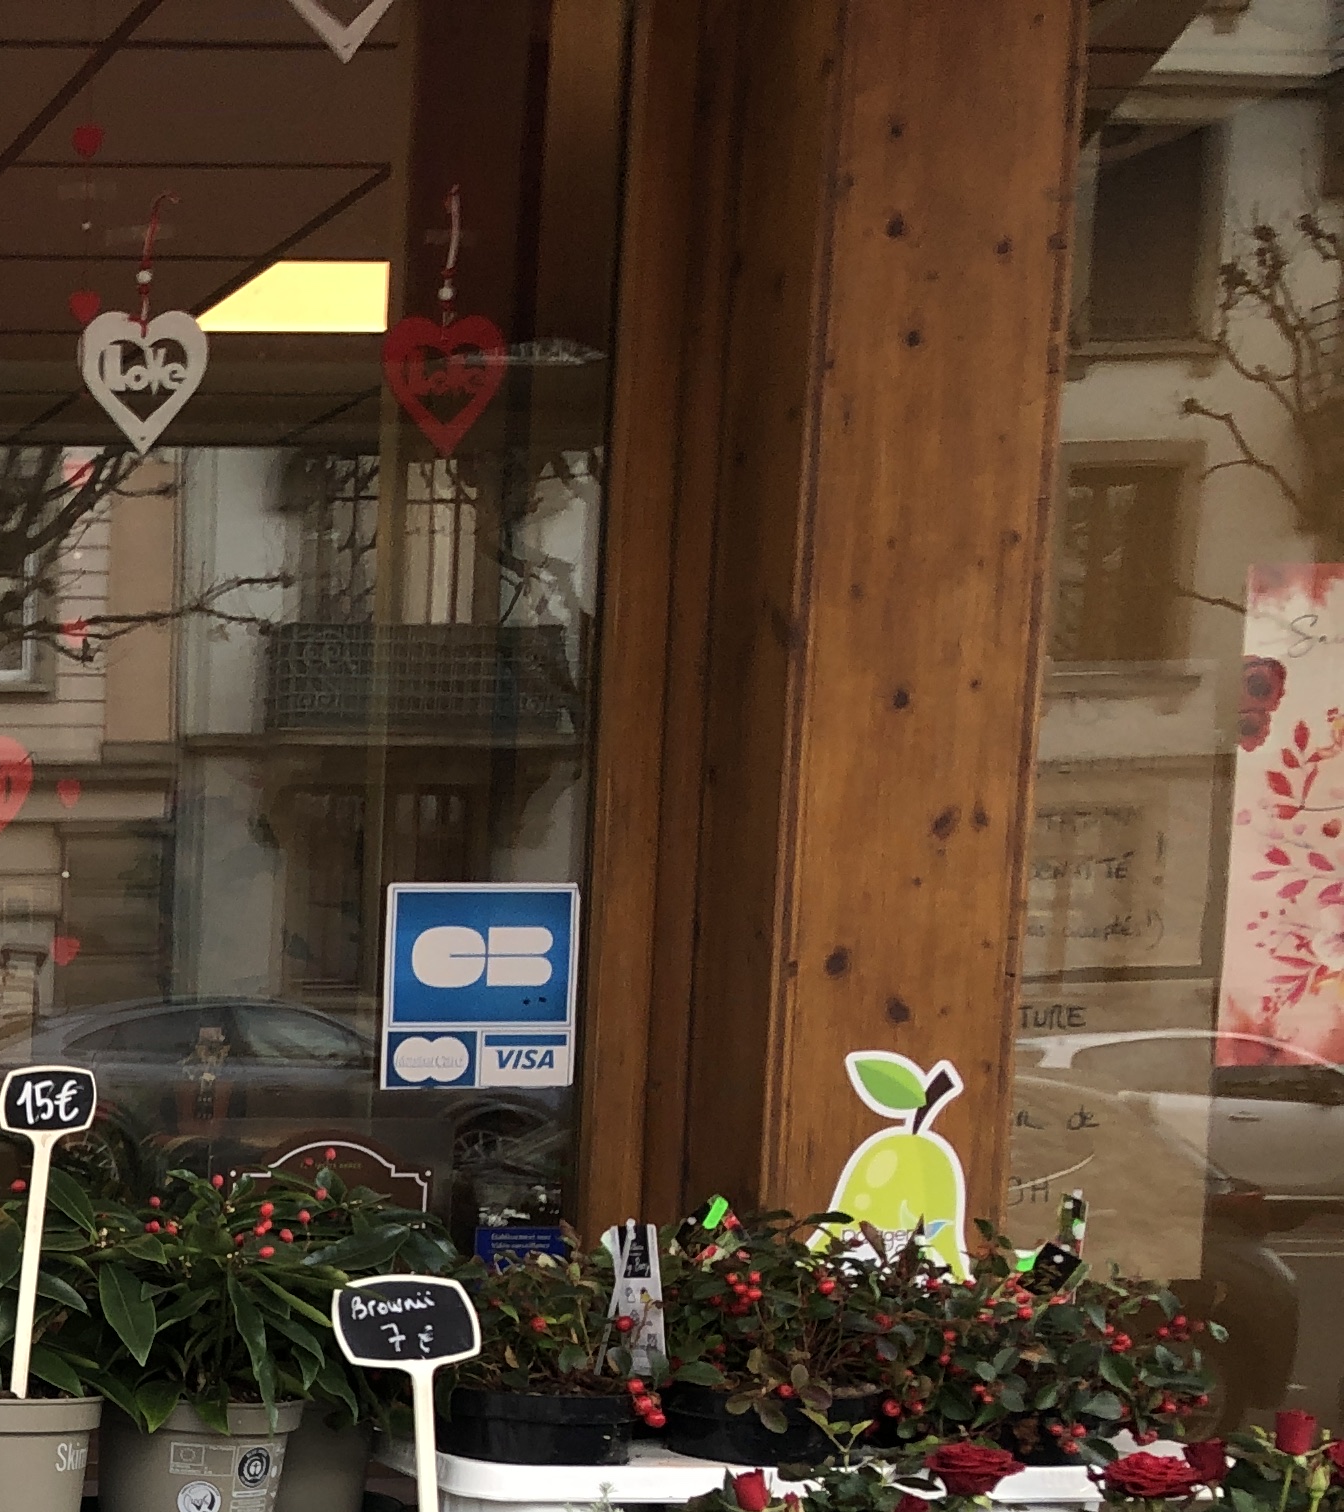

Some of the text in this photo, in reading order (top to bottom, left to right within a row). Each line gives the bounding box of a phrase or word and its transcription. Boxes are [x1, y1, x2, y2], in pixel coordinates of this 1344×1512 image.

[105, 343, 188, 395] Love
[412, 925, 554, 989] CB
[496, 1049, 555, 1070] VISA
[16, 1079, 80, 1125] 15€
[351, 1290, 435, 1320] Brownii
[380, 1322, 406, 1352] 7
